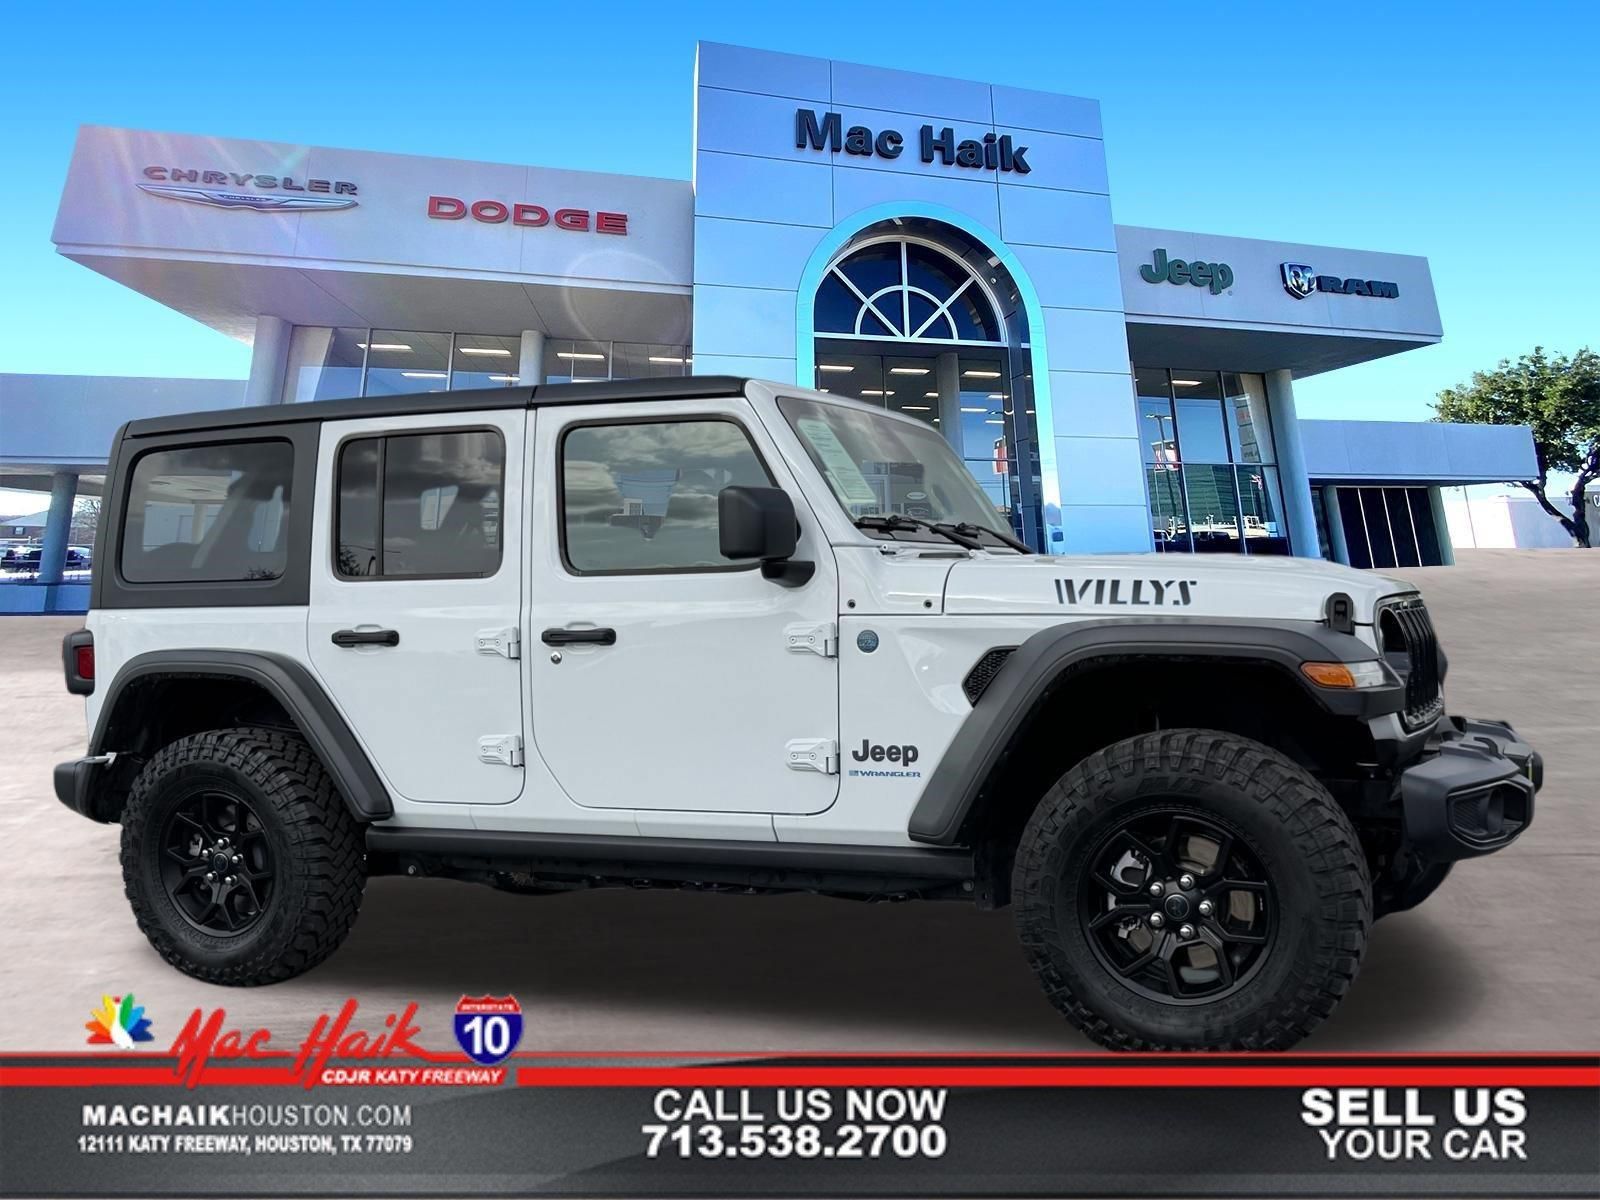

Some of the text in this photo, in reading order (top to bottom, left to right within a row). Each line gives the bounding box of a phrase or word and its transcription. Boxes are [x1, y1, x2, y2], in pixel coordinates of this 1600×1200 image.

[796, 108, 1031, 174] Mac Haik
[143, 166, 358, 195] CHRYSLER
[428, 196, 628, 236] DODGE
[1140, 248, 1234, 295] Jeep
[1316, 275, 1399, 299] RAM
[1054, 578, 1198, 606] WILLYS
[851, 738, 919, 767] Jeep
[860, 770, 921, 778] WRANGLER
